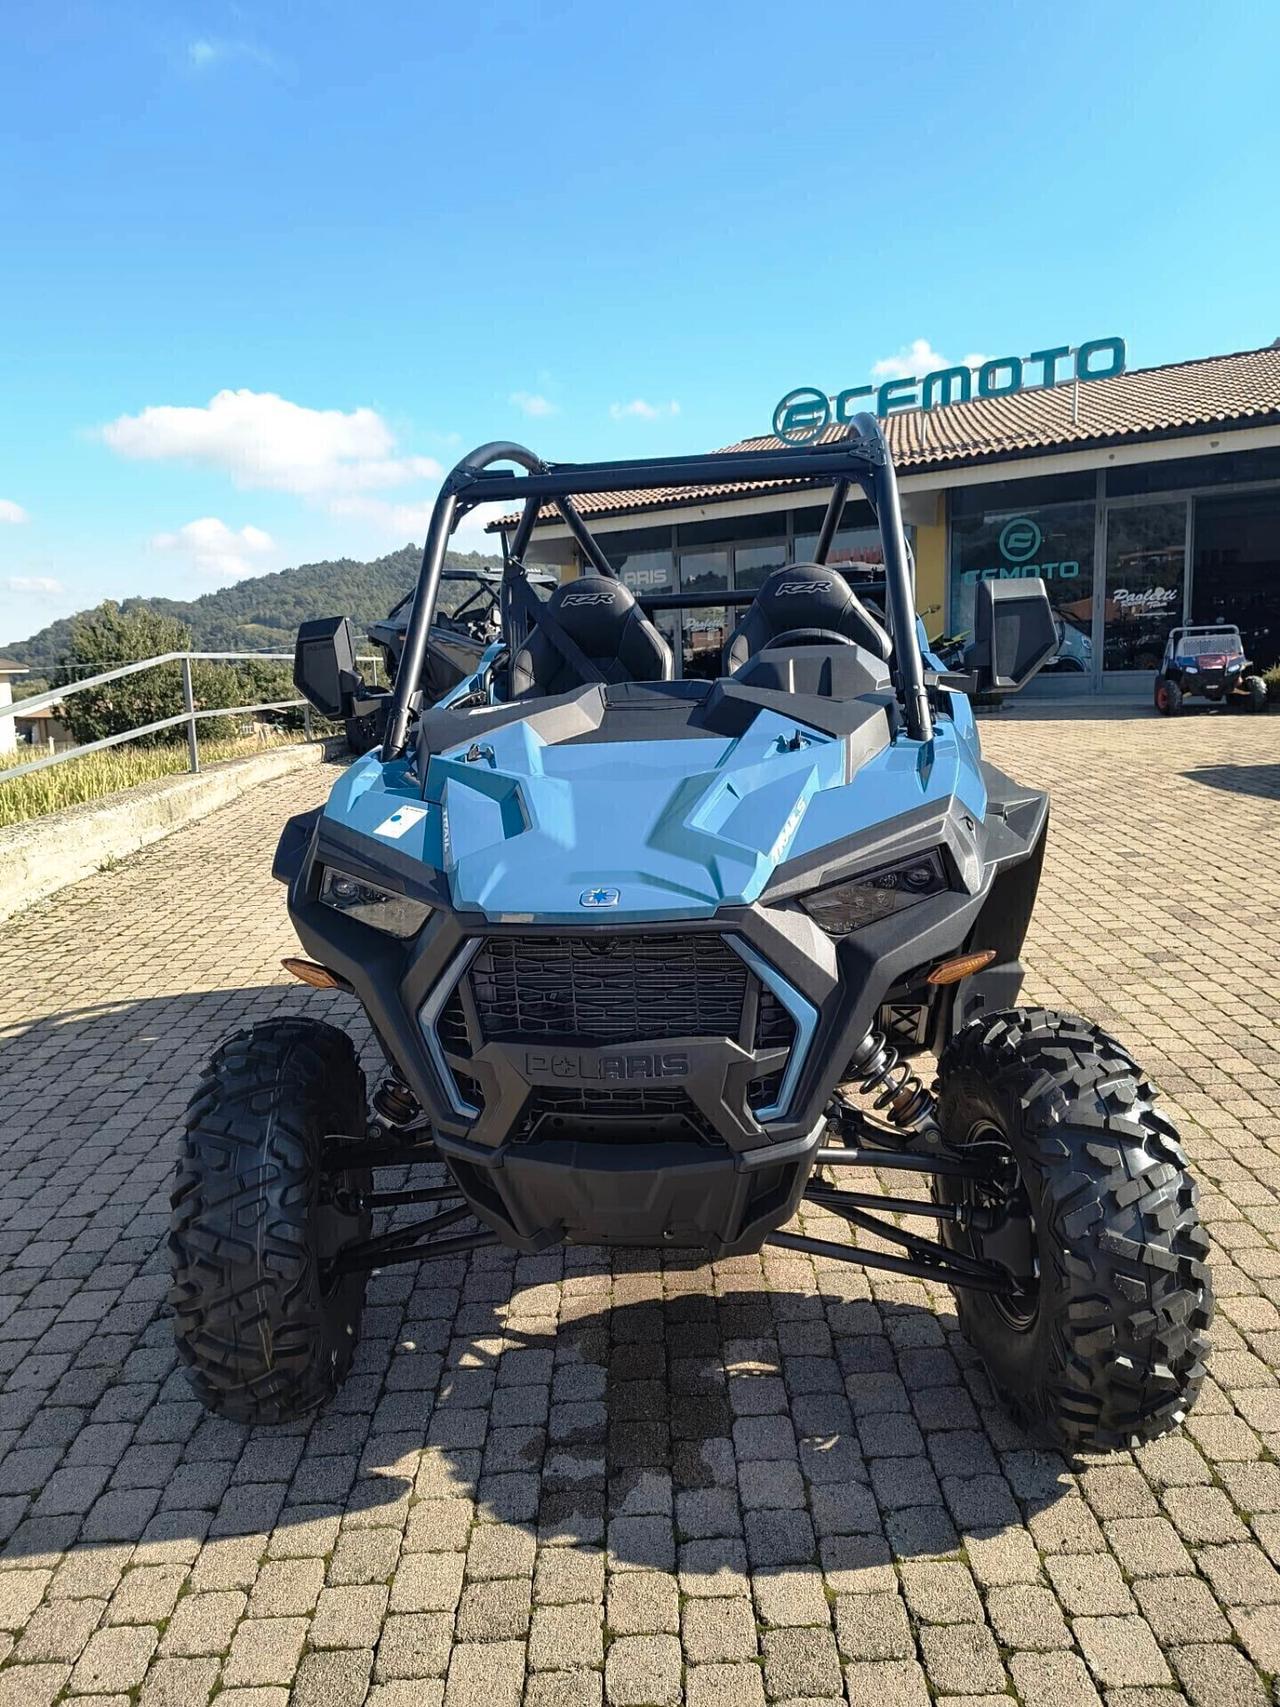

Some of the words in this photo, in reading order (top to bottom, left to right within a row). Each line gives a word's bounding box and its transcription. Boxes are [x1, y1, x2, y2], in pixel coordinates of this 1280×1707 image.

[836, 336, 1126, 422] CFMOTO
[623, 568, 668, 585] ARIS
[775, 580, 833, 596] RZR
[560, 592, 616, 608] RZR
[525, 1052, 690, 1080] POLARIS
